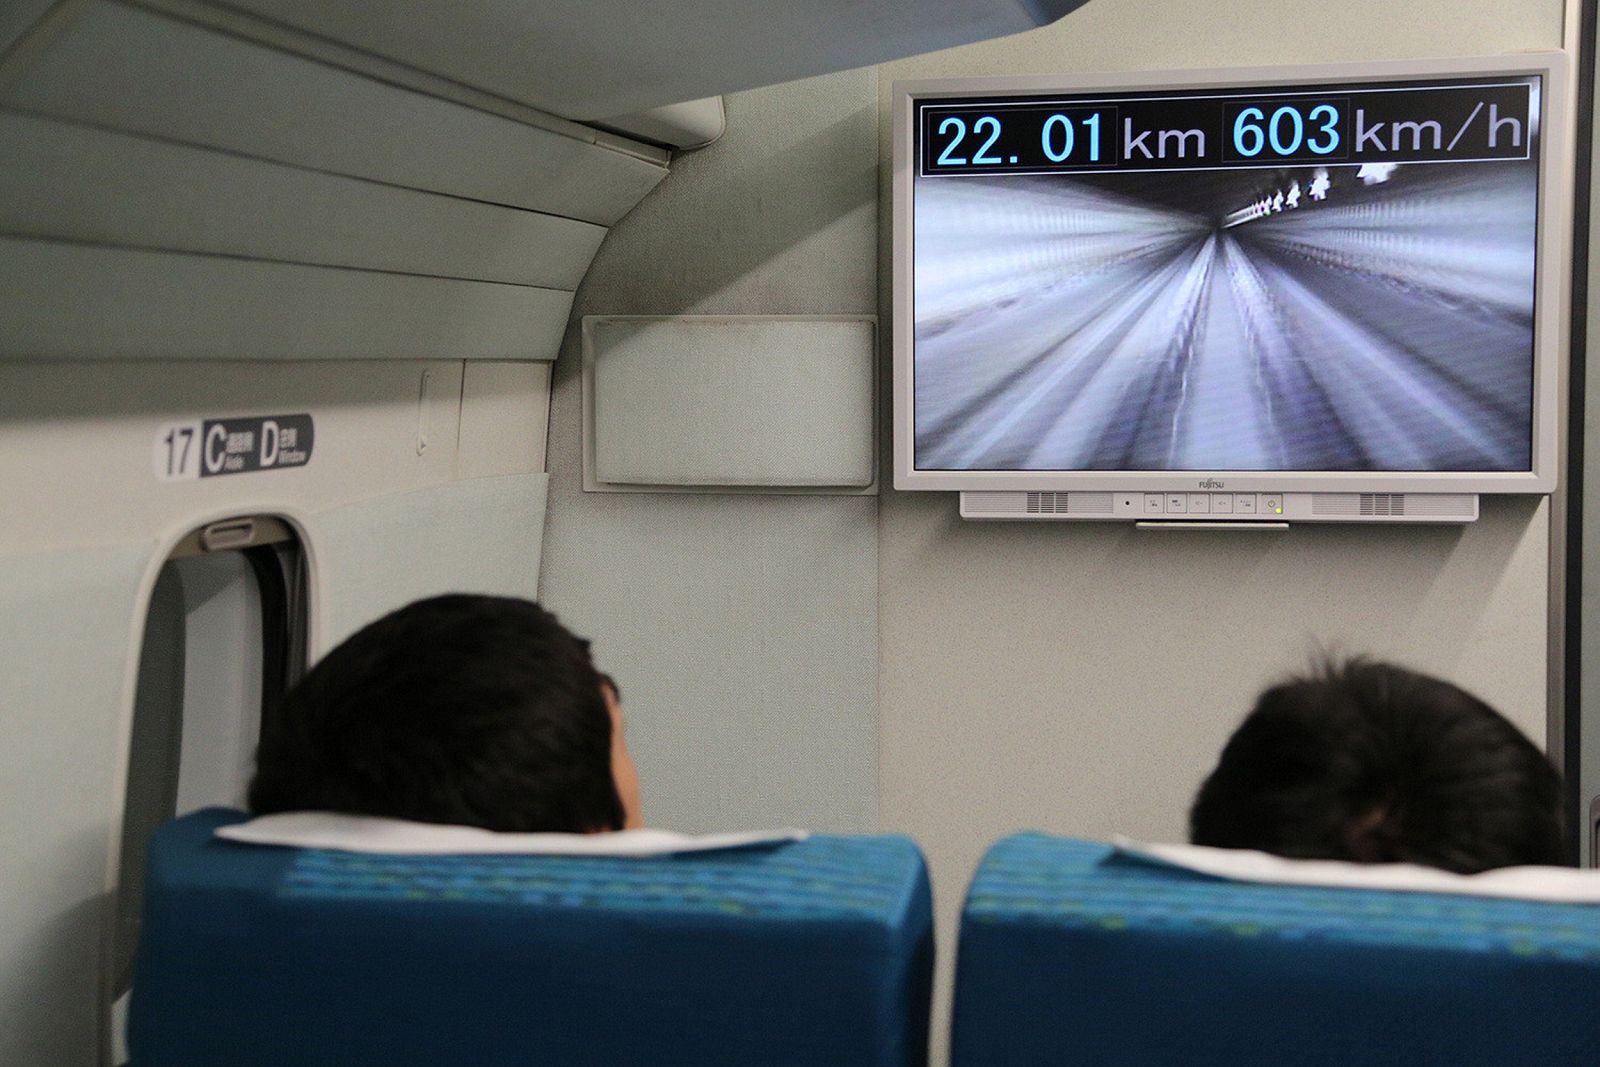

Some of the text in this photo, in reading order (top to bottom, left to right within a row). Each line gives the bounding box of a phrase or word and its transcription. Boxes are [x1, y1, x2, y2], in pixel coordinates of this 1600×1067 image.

[1123, 116, 1206, 161] km
[1232, 105, 1341, 156] 603
[1354, 101, 1525, 154] km/h
[164, 428, 194, 475] 17
[205, 424, 227, 473] C
[260, 420, 280, 467] D
[1199, 478, 1224, 490] FUJITSU
